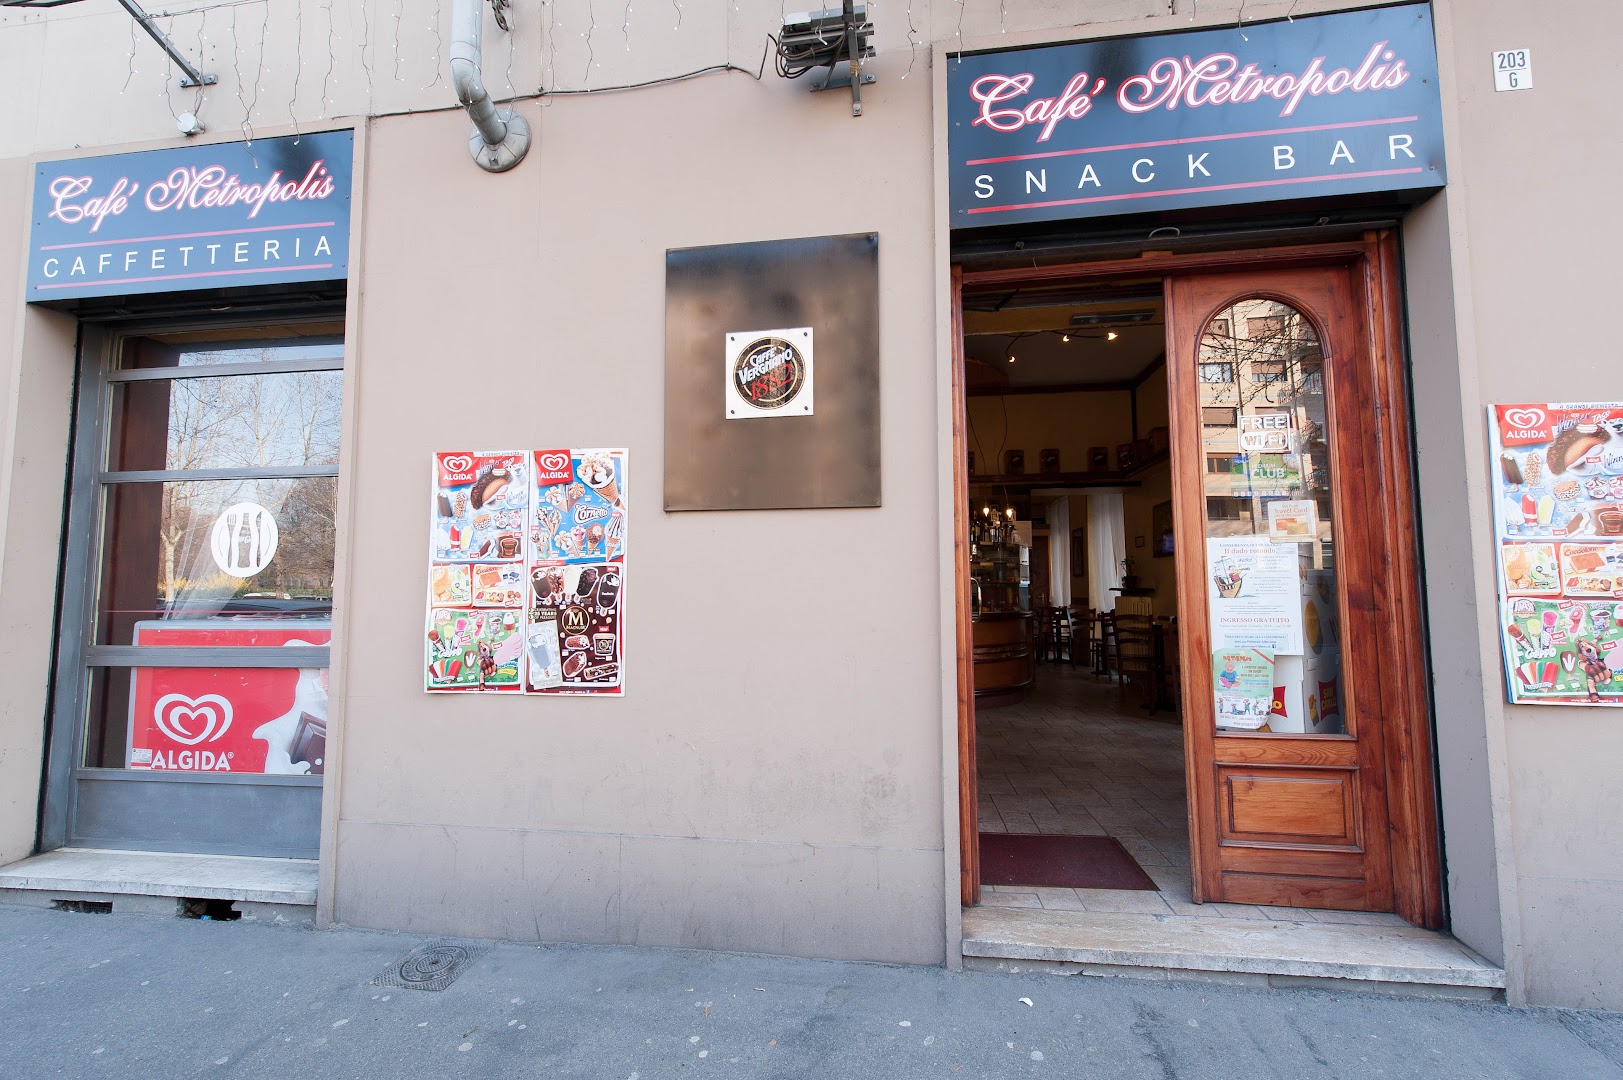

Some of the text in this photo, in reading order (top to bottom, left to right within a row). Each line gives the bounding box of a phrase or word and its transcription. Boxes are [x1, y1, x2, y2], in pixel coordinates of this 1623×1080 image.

[1117, 40, 1410, 117] Metropolis
[1497, 51, 1526, 69] 203
[1509, 72, 1518, 88] G
[974, 134, 1416, 200] SNACK BAR
[145, 159, 335, 220] Metropolis
[43, 235, 332, 278] CAFFETTERIA
[738, 347, 794, 385] VERGNANO
[751, 363, 794, 401] 1882
[1240, 416, 1287, 430] FREE
[1251, 468, 1285, 478] CLUB
[574, 504, 609, 524] Cornetto
